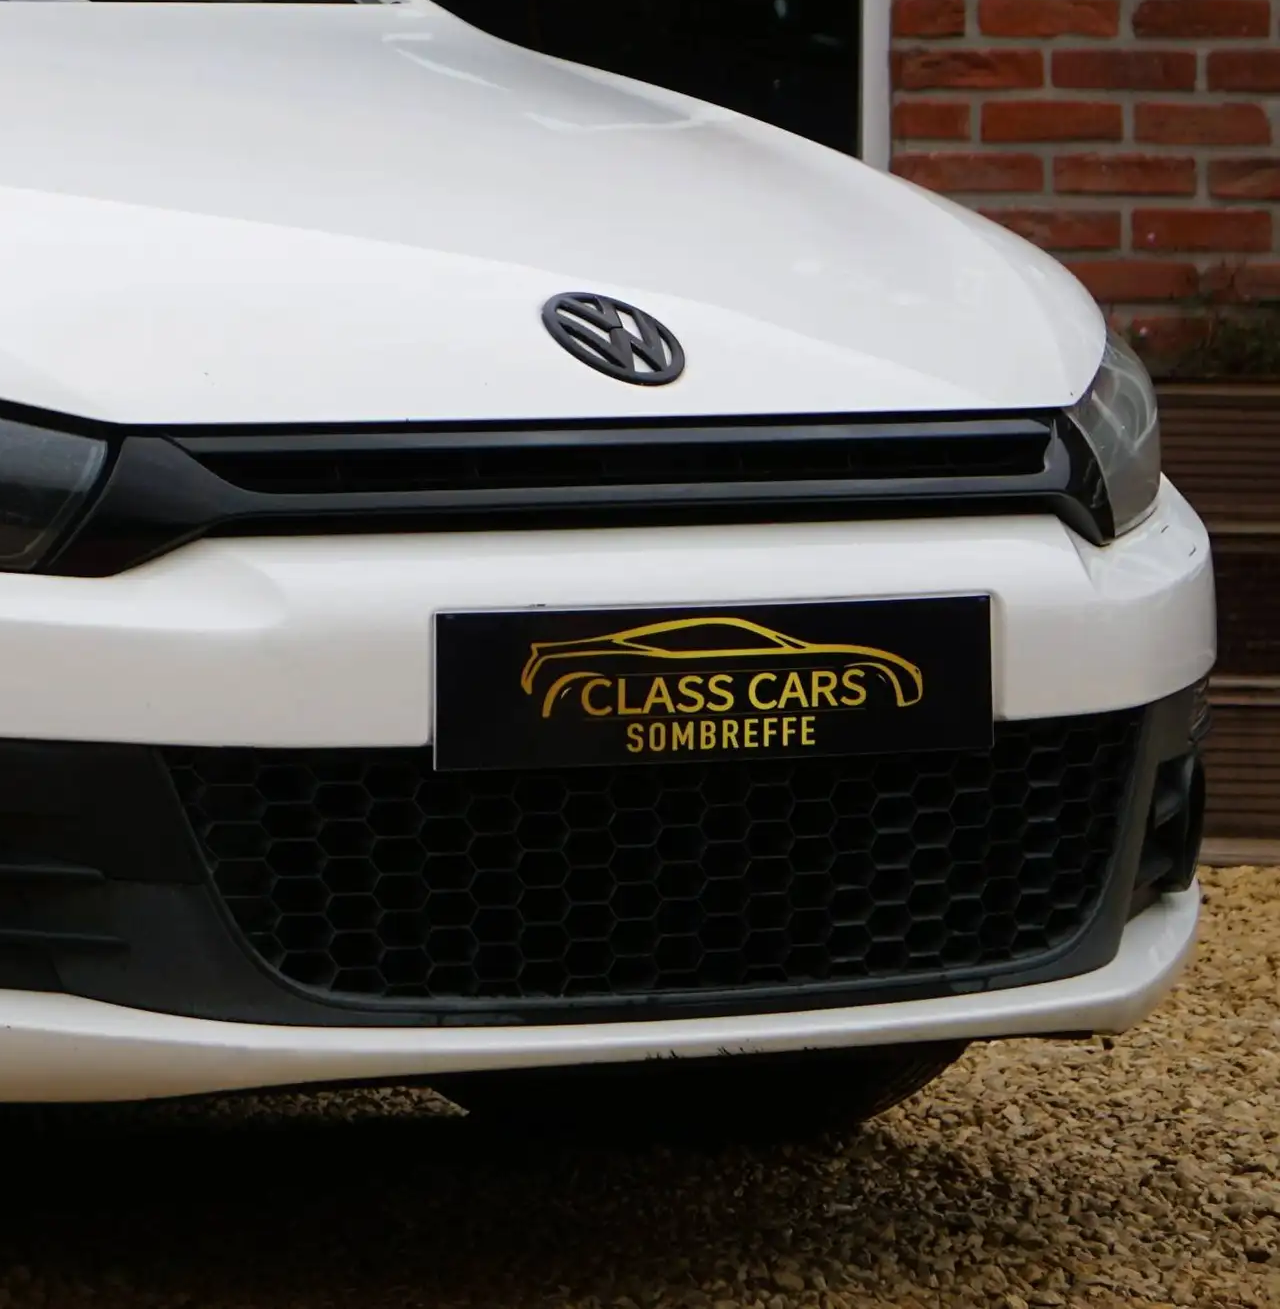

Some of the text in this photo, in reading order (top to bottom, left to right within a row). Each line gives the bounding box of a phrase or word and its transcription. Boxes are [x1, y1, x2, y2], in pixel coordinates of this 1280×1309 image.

[580, 668, 867, 716] CLASS CARS
[626, 715, 816, 753] SOMBREFFE
